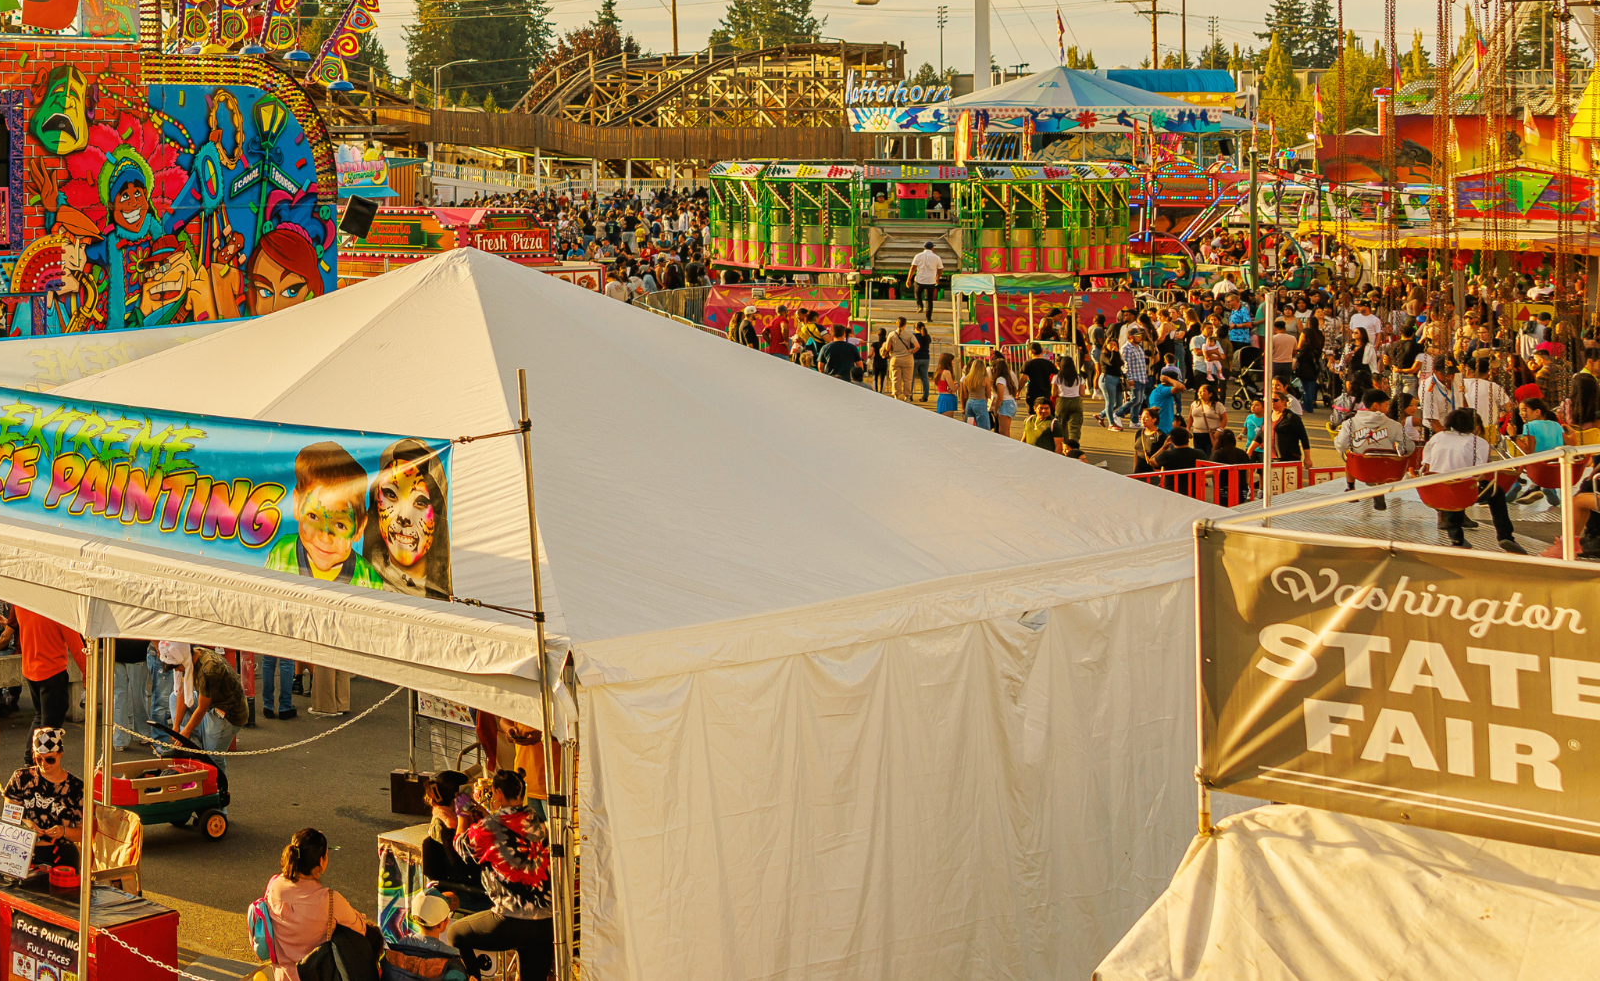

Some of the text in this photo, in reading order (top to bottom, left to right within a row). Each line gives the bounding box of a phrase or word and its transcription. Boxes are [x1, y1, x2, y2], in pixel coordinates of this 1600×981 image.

[845, 69, 953, 105] Matterhorn
[237, 167, 260, 189] CANAL
[366, 232, 410, 247] Suprema
[371, 221, 411, 235] Pizzaria
[474, 232, 544, 251] Fresh Pizza
[43, 450, 288, 550] PAINTING
[1270, 565, 1587, 639] Washington
[1255, 622, 1600, 720] STATE
[1303, 697, 1565, 793] FAIR
[2, 843, 19, 854] HERE
[16, 919, 79, 952] FACE PAINTING
[26, 942, 71, 966] FULL FACES
